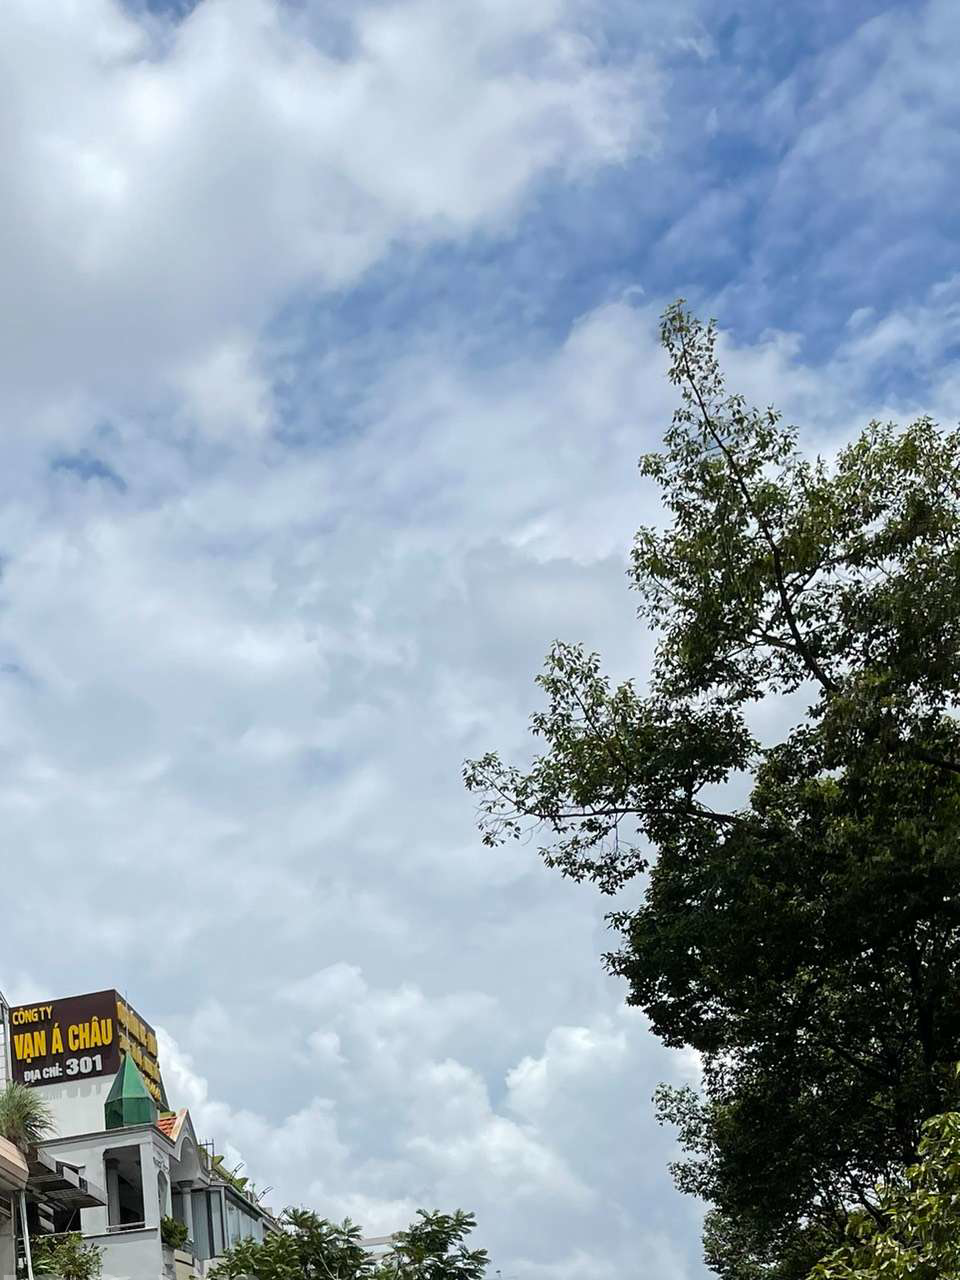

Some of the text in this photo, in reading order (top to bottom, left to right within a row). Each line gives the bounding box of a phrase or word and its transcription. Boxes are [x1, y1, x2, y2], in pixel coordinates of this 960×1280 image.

[12, 1004, 53, 1025] CÔNG TY
[14, 1015, 113, 1063] VẠN Á CHÂU
[65, 1054, 103, 1076] 301
